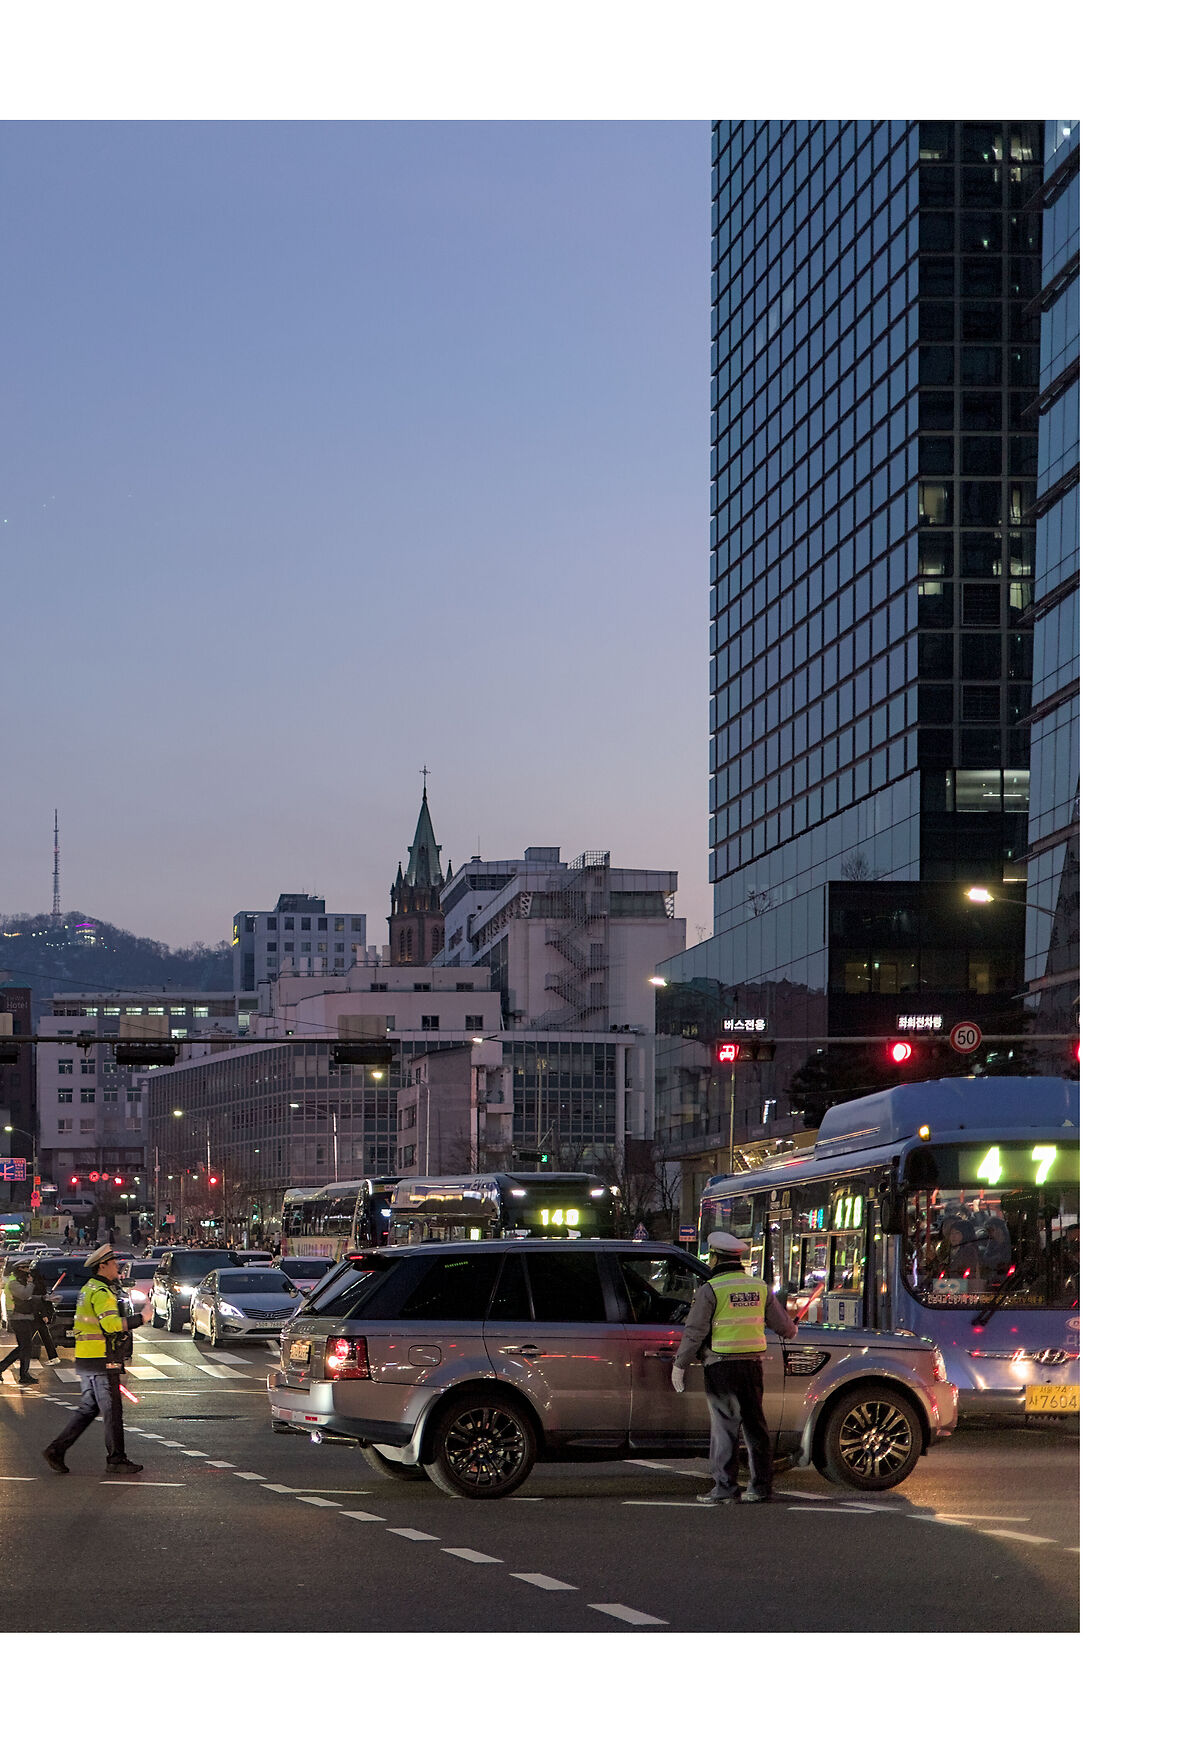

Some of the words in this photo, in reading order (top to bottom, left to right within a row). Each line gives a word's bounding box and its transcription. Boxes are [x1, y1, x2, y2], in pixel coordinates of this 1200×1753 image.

[723, 1019, 766, 1031] 버스전용
[898, 1016, 942, 1029] 좌회전차량
[957, 1030, 975, 1045] 50
[540, 1208, 579, 1226] 140
